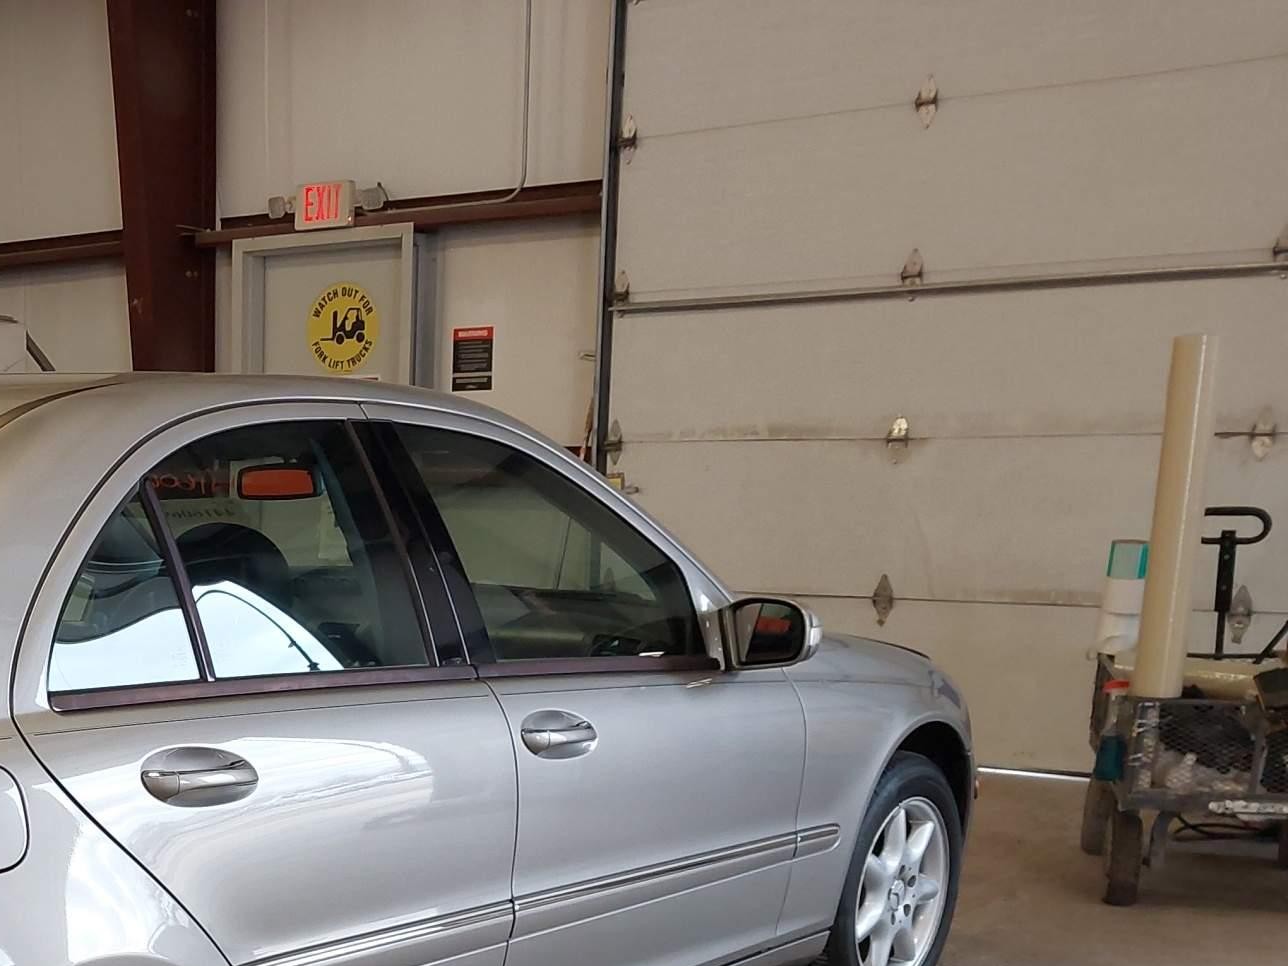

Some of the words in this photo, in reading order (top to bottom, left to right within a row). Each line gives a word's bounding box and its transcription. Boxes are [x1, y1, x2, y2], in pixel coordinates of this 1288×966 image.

[305, 186, 341, 222] EXIT
[313, 289, 339, 319] WATCH
[341, 286, 359, 299] OUT
[358, 293, 374, 316] FOR
[312, 341, 328, 364] FORK
[328, 359, 345, 370] LIFT
[347, 339, 373, 369] TRUCKS
